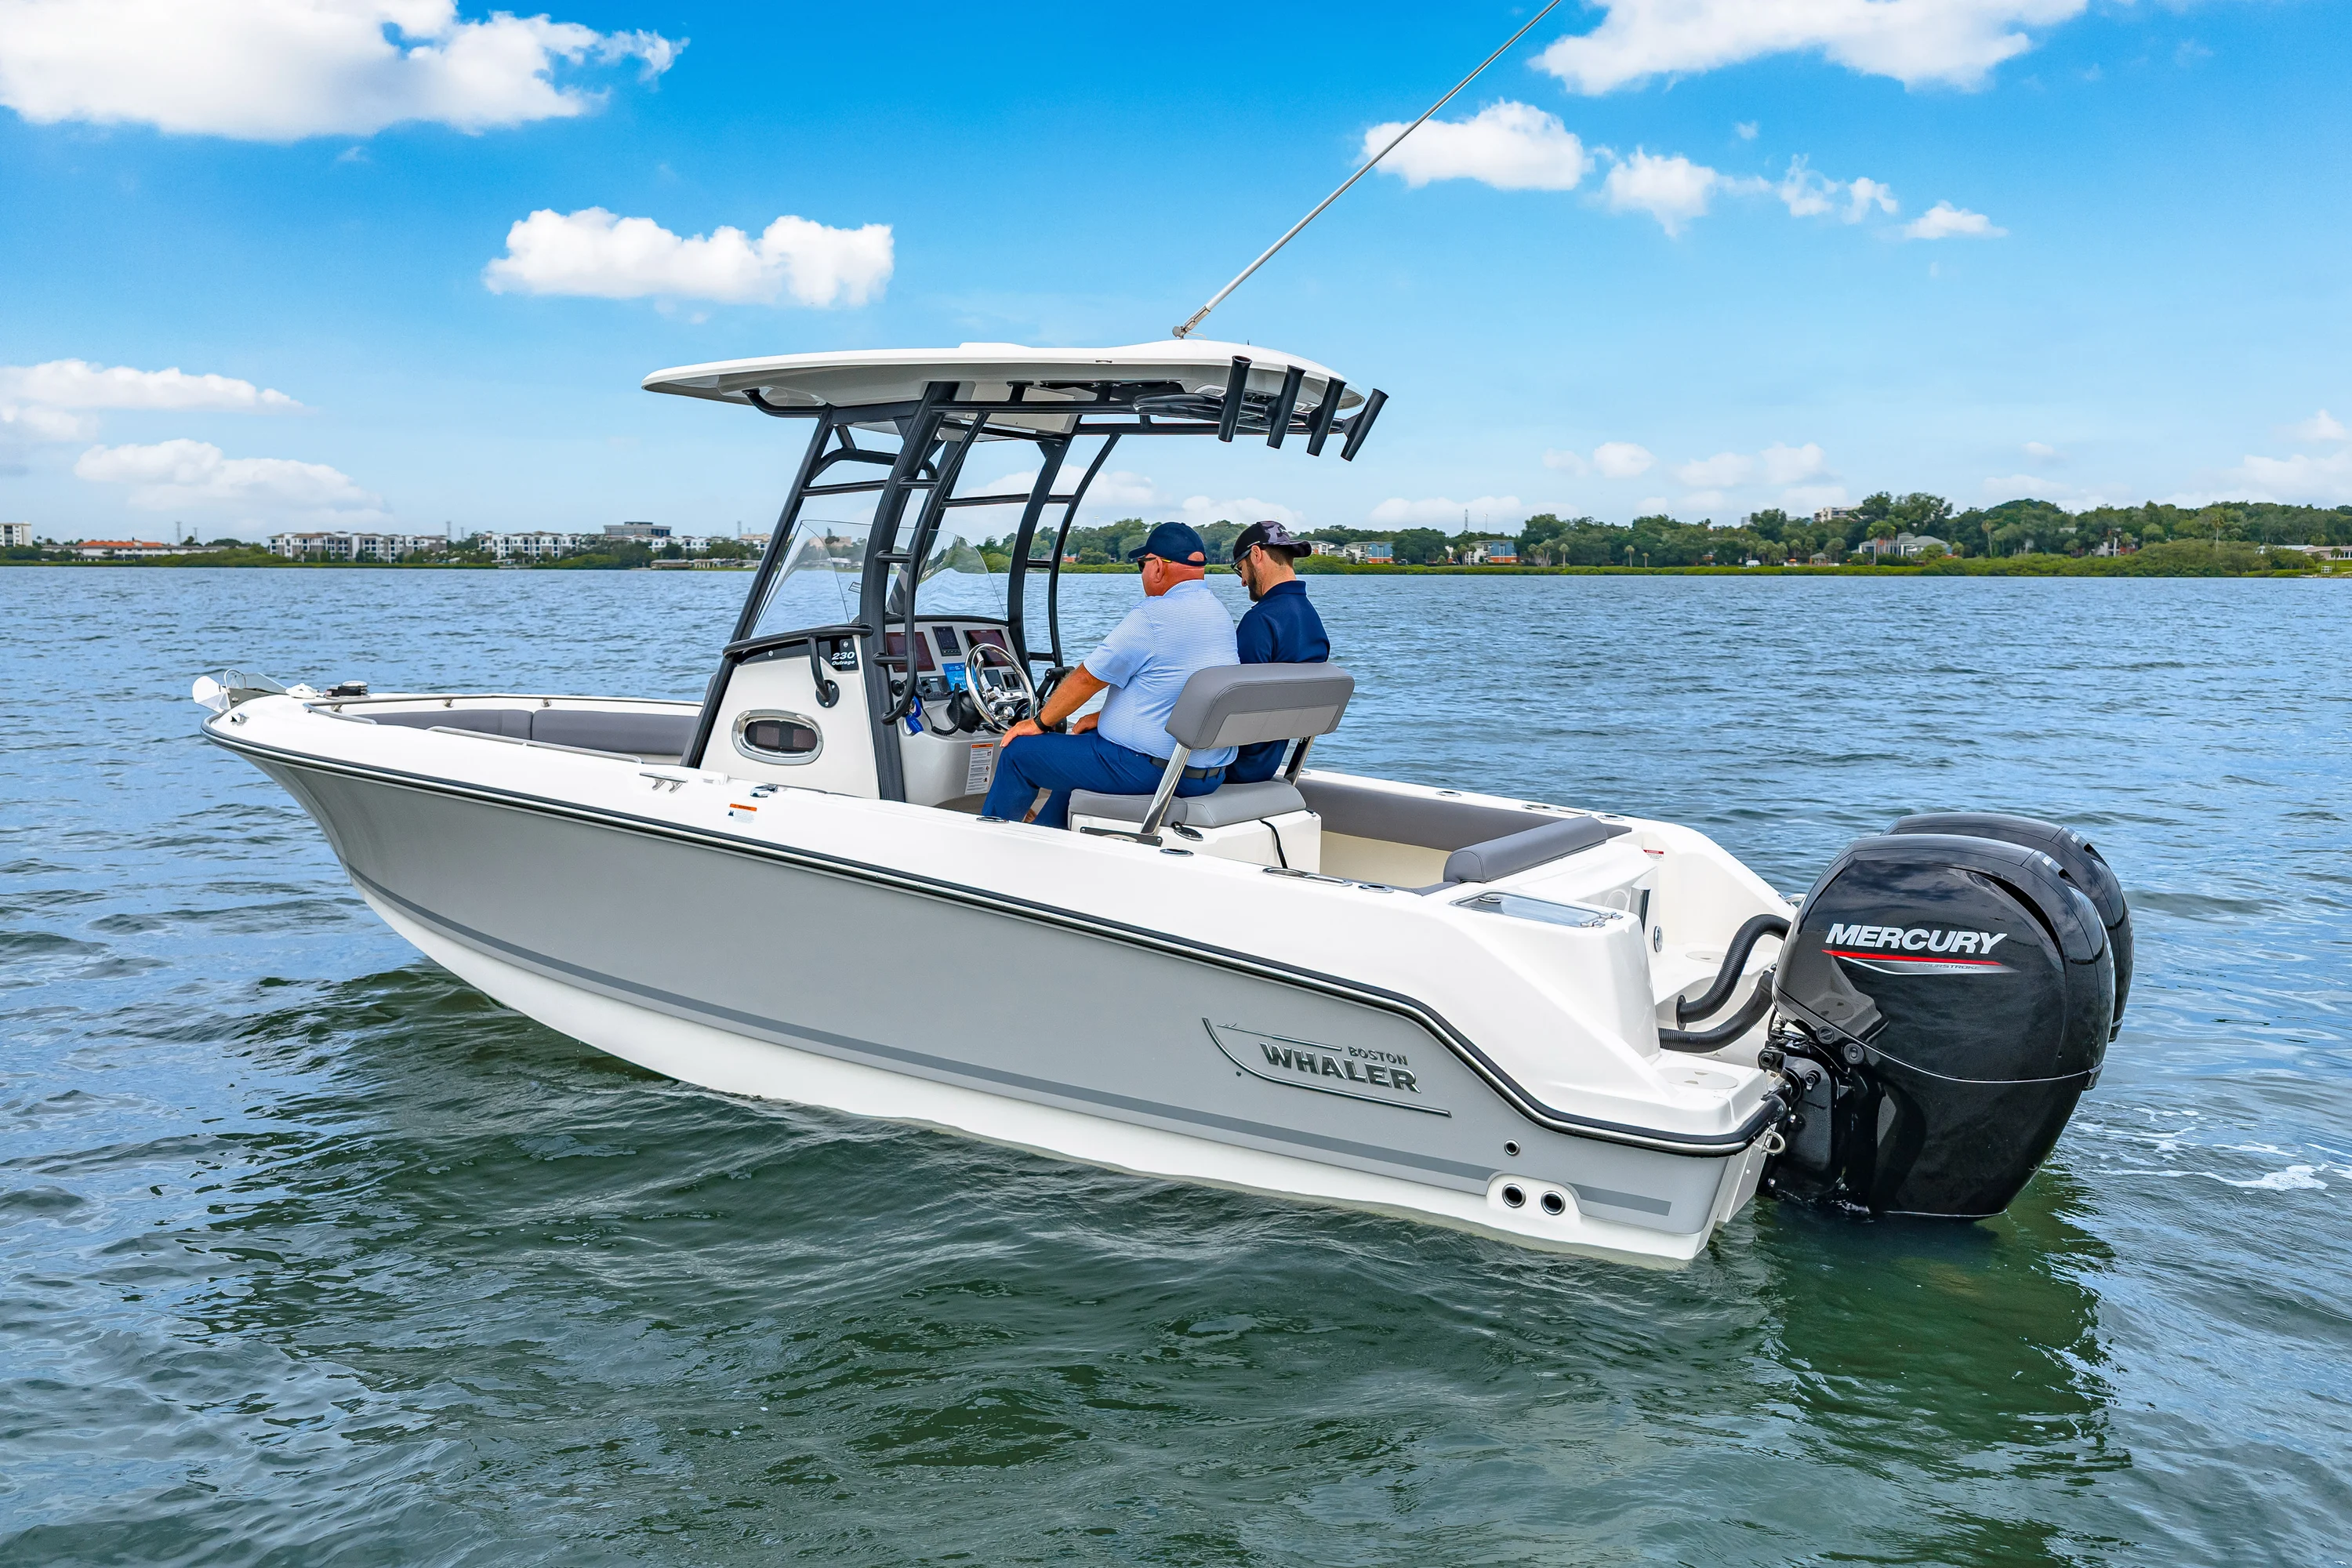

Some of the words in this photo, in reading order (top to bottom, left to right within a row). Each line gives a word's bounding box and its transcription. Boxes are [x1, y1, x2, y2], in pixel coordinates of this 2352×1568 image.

[832, 652, 855, 660] 230
[1825, 923, 2008, 954] MERCURY
[1259, 1041, 1421, 1094] WHALER
[1348, 1045, 1408, 1065] BOSTON
